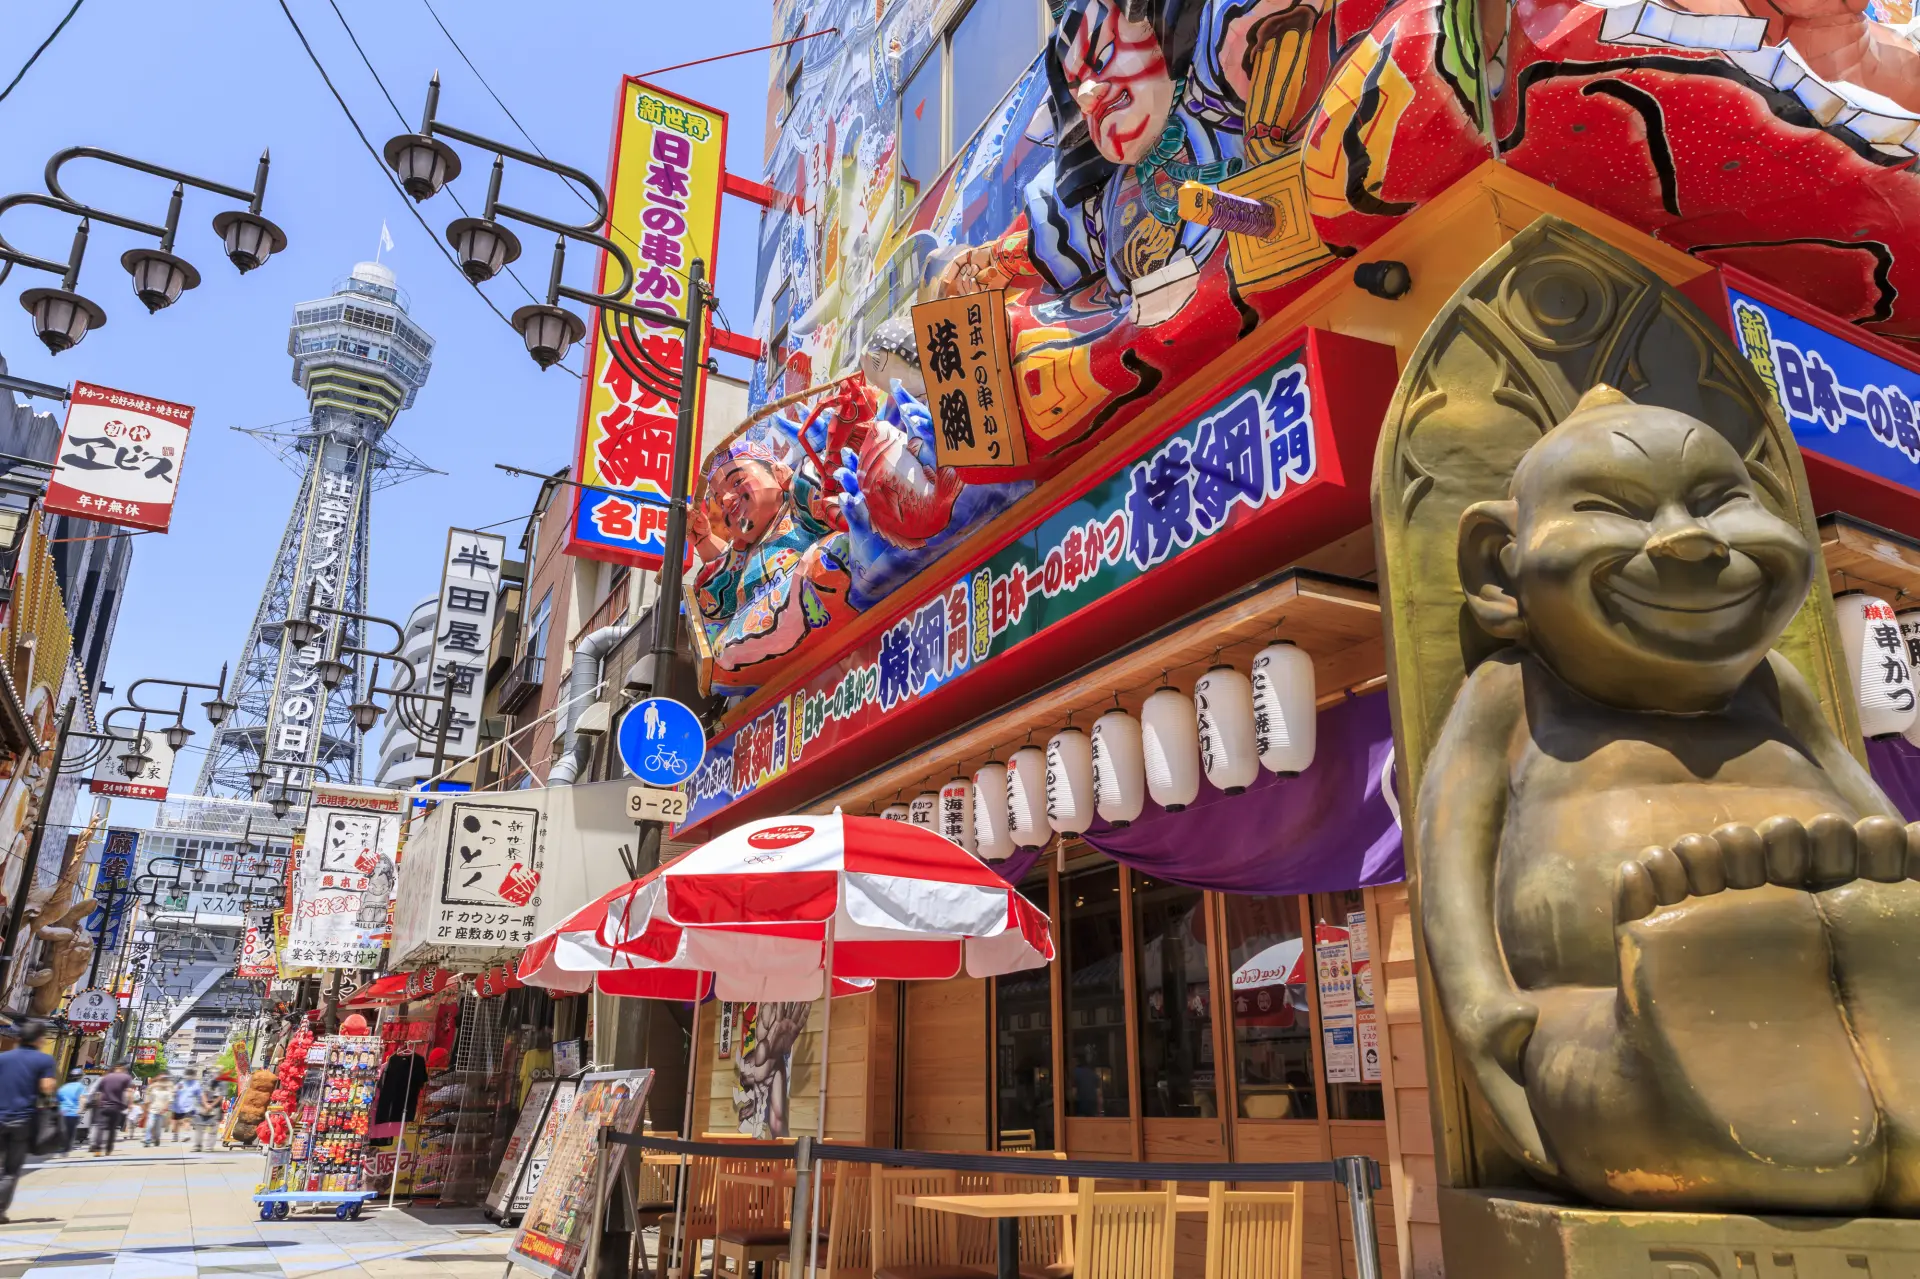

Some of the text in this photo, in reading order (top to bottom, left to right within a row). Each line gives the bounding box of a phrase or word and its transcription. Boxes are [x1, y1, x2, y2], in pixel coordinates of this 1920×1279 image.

[638, 95, 709, 141] 新世界
[635, 129, 692, 329] 日本一の串かつ
[927, 319, 975, 451] 横綱
[967, 304, 1000, 459] 日本一の串かつ
[1775, 346, 1920, 458] 日本一の串
[76, 494, 140, 517] 年中無休
[991, 514, 1125, 633] 日本一の串かつ
[426, 544, 499, 742] 半田屋酒店
[1873, 623, 1915, 711] 串かつ
[803, 667, 878, 741] 日本一の串かつ
[299, 895, 361, 919] 大阪名物
[454, 927, 535, 943] 座敷あります
[291, 948, 379, 964] 宴会予約受付中
